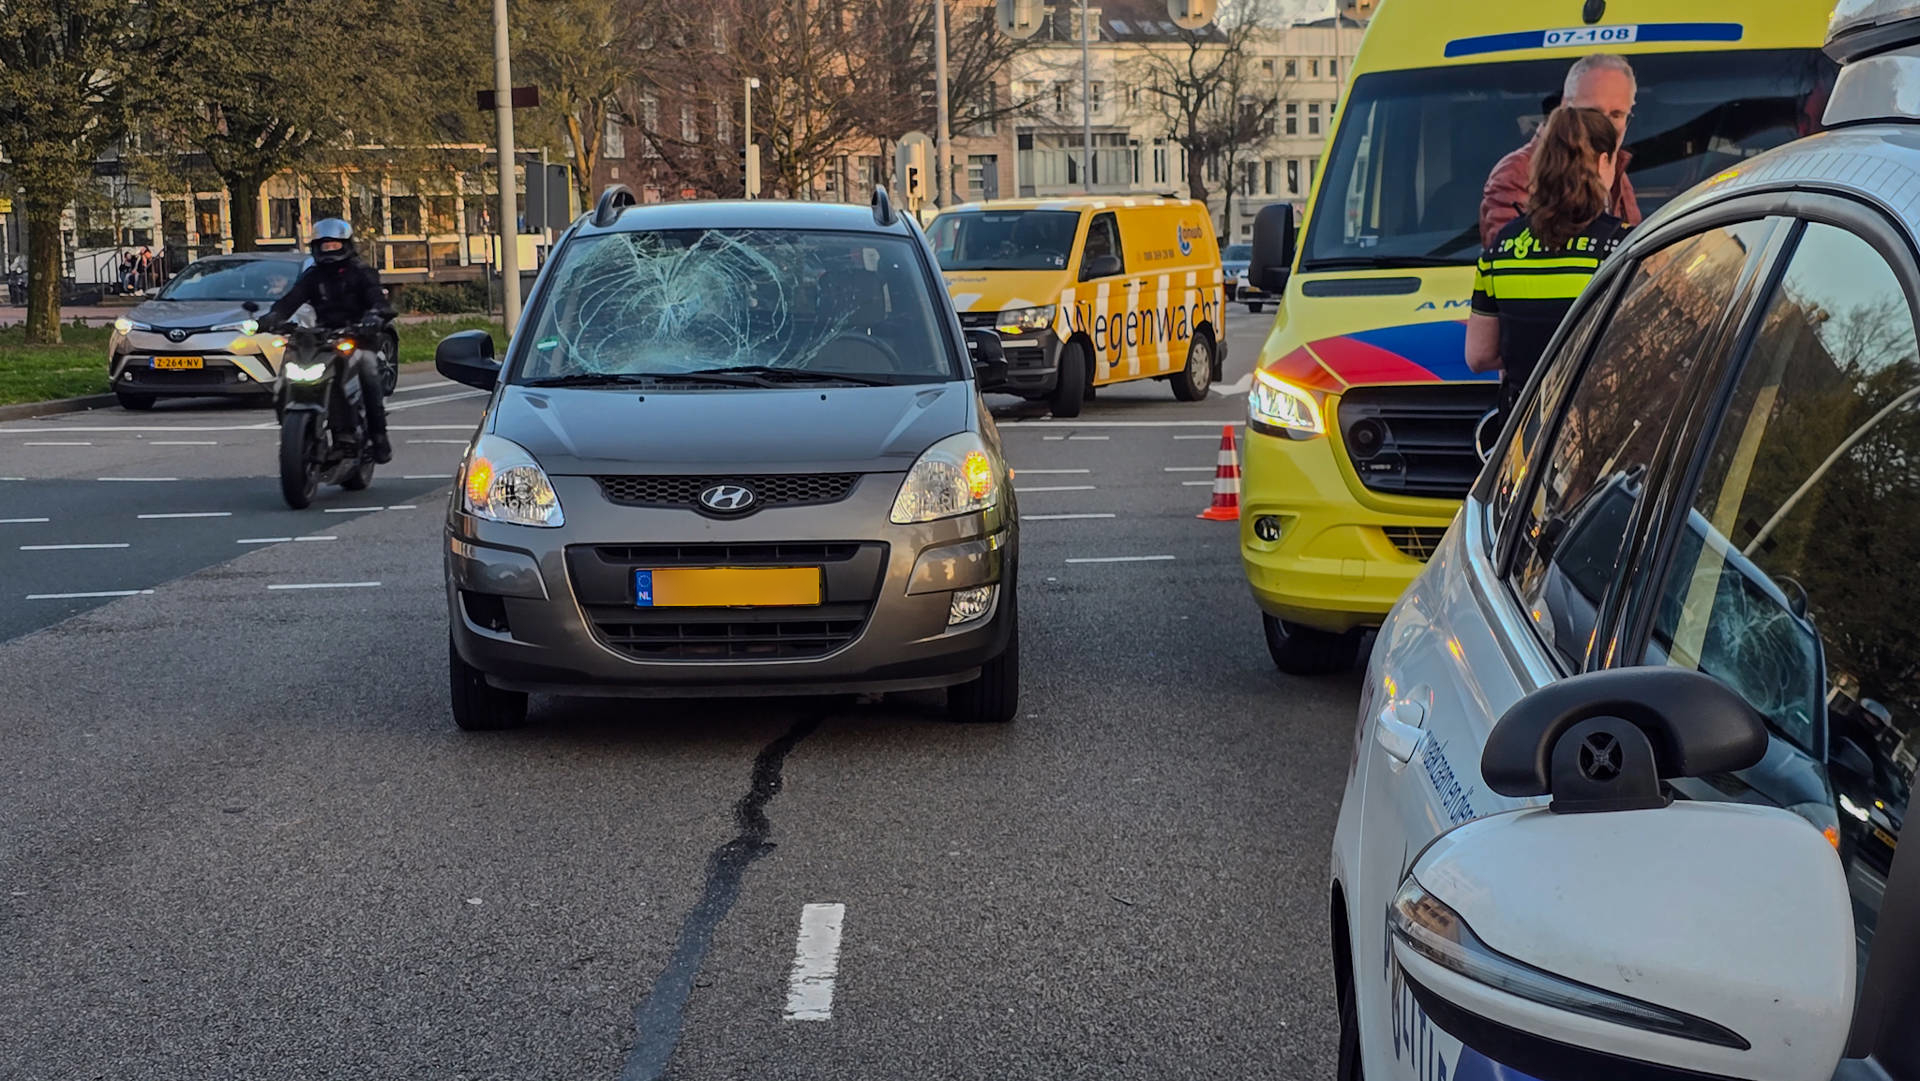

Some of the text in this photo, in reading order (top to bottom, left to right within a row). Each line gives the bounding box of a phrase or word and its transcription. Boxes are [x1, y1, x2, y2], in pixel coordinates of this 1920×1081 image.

[1547, 28, 1629, 44] 07-108
[1063, 287, 1219, 368] Wegenwacht
[638, 591, 652, 601] NL
